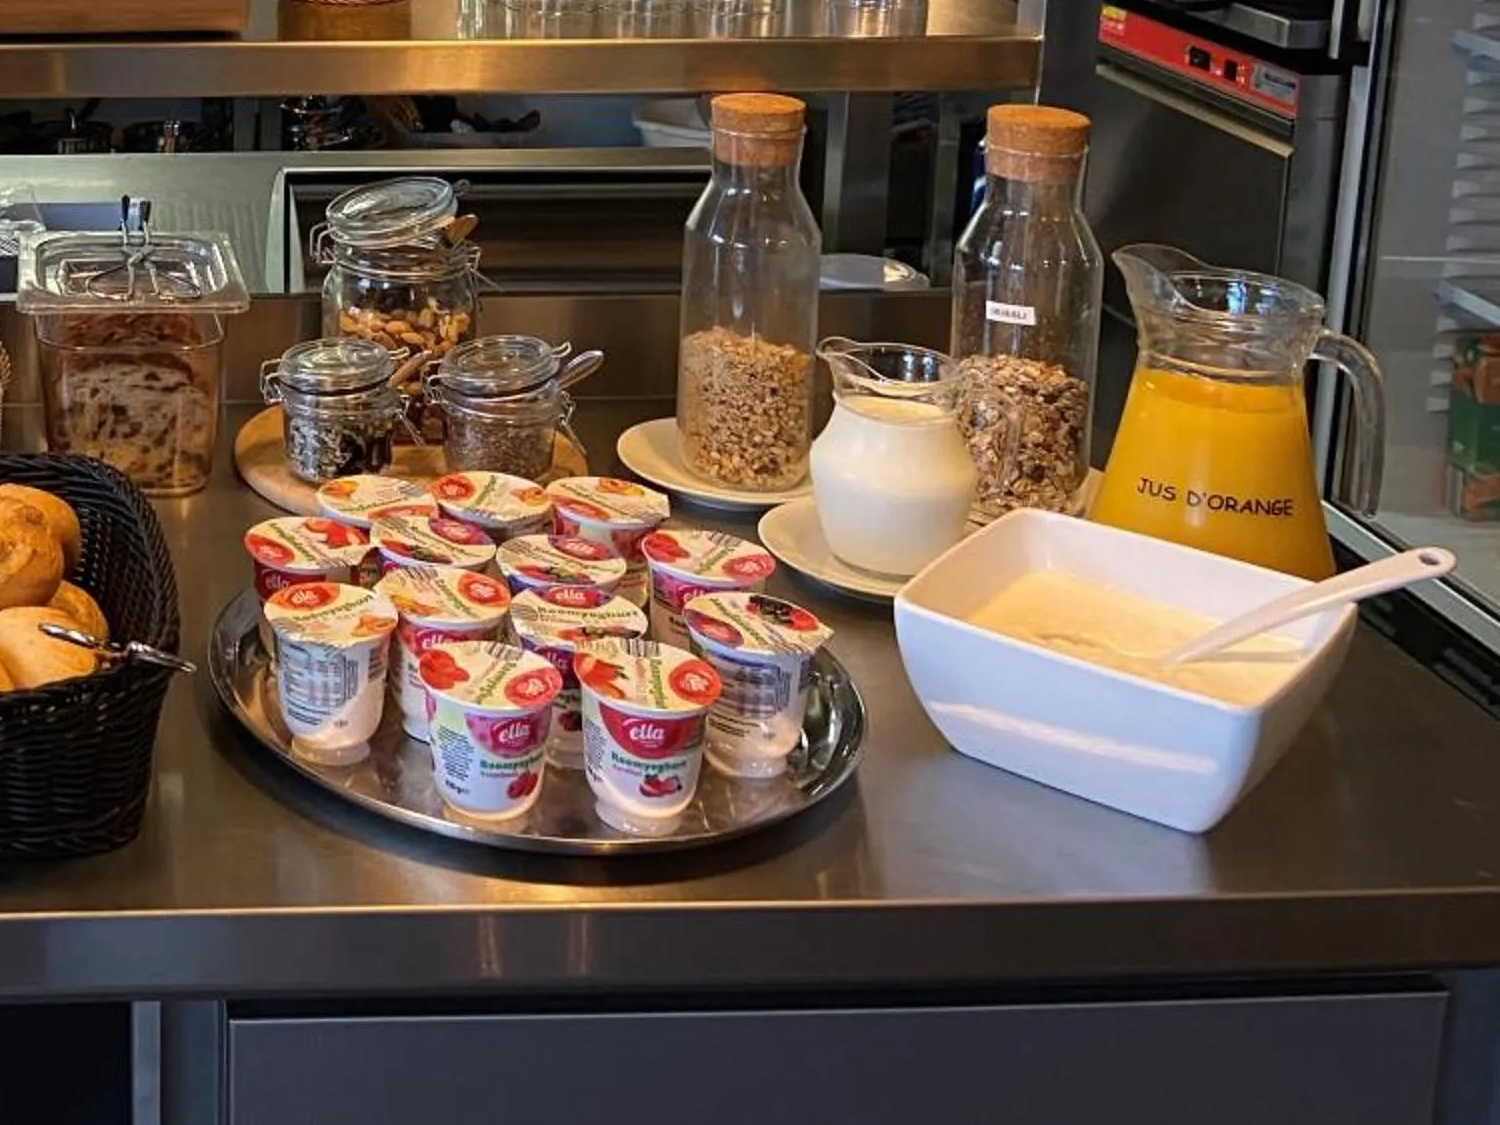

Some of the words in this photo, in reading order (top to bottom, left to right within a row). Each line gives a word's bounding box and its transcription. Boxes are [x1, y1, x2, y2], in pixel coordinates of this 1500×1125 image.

[1137, 476, 1177, 502] JUS
[1186, 489, 1294, 517] D'ORANGE
[555, 588, 586, 601] ella
[499, 721, 531, 743] ella
[629, 722, 665, 741] ella
